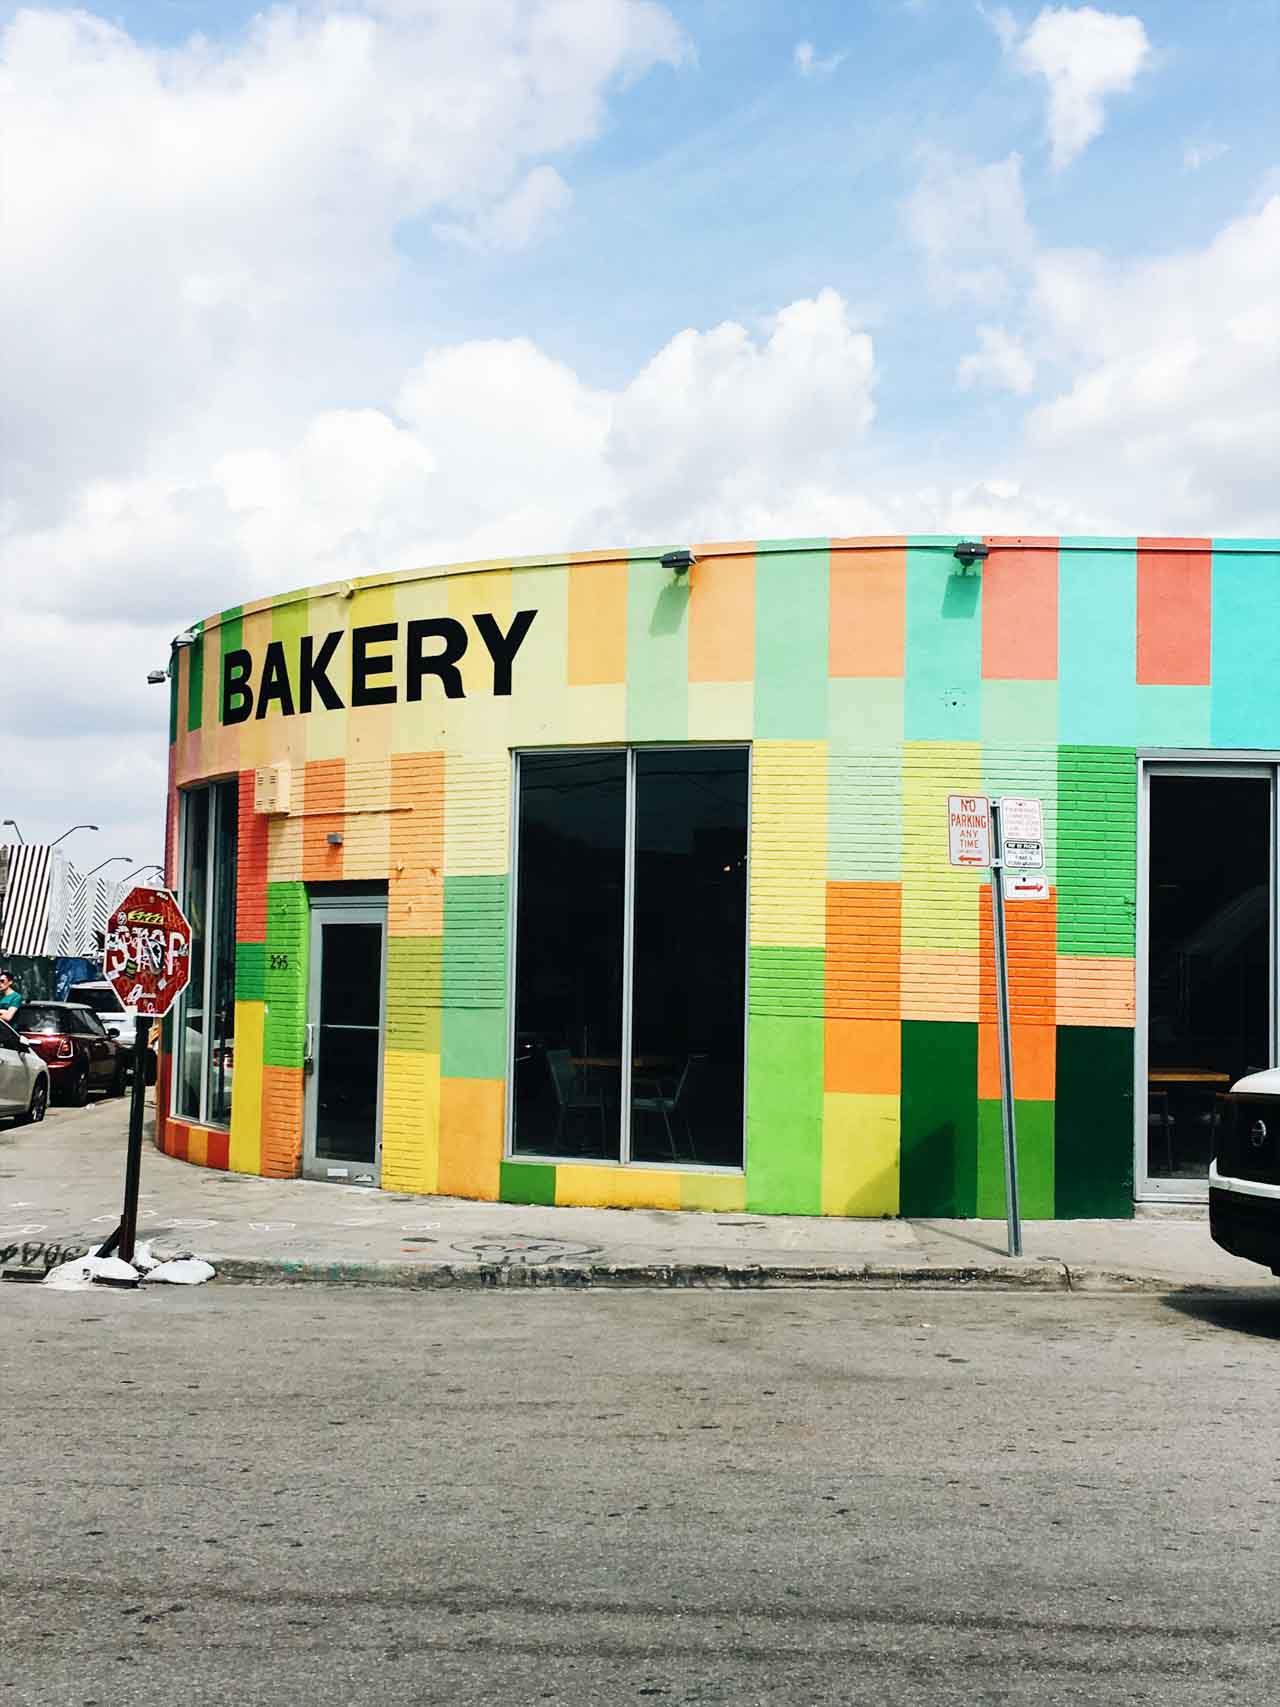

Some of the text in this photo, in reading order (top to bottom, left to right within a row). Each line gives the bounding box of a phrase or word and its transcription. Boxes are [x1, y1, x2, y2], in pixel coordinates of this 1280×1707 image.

[222, 609, 538, 726] BAKERY
[960, 799, 976, 812] NO
[951, 814, 986, 828] PARKING
[960, 830, 978, 838] ANY
[960, 840, 978, 848] TIME
[108, 926, 185, 976] STOP
